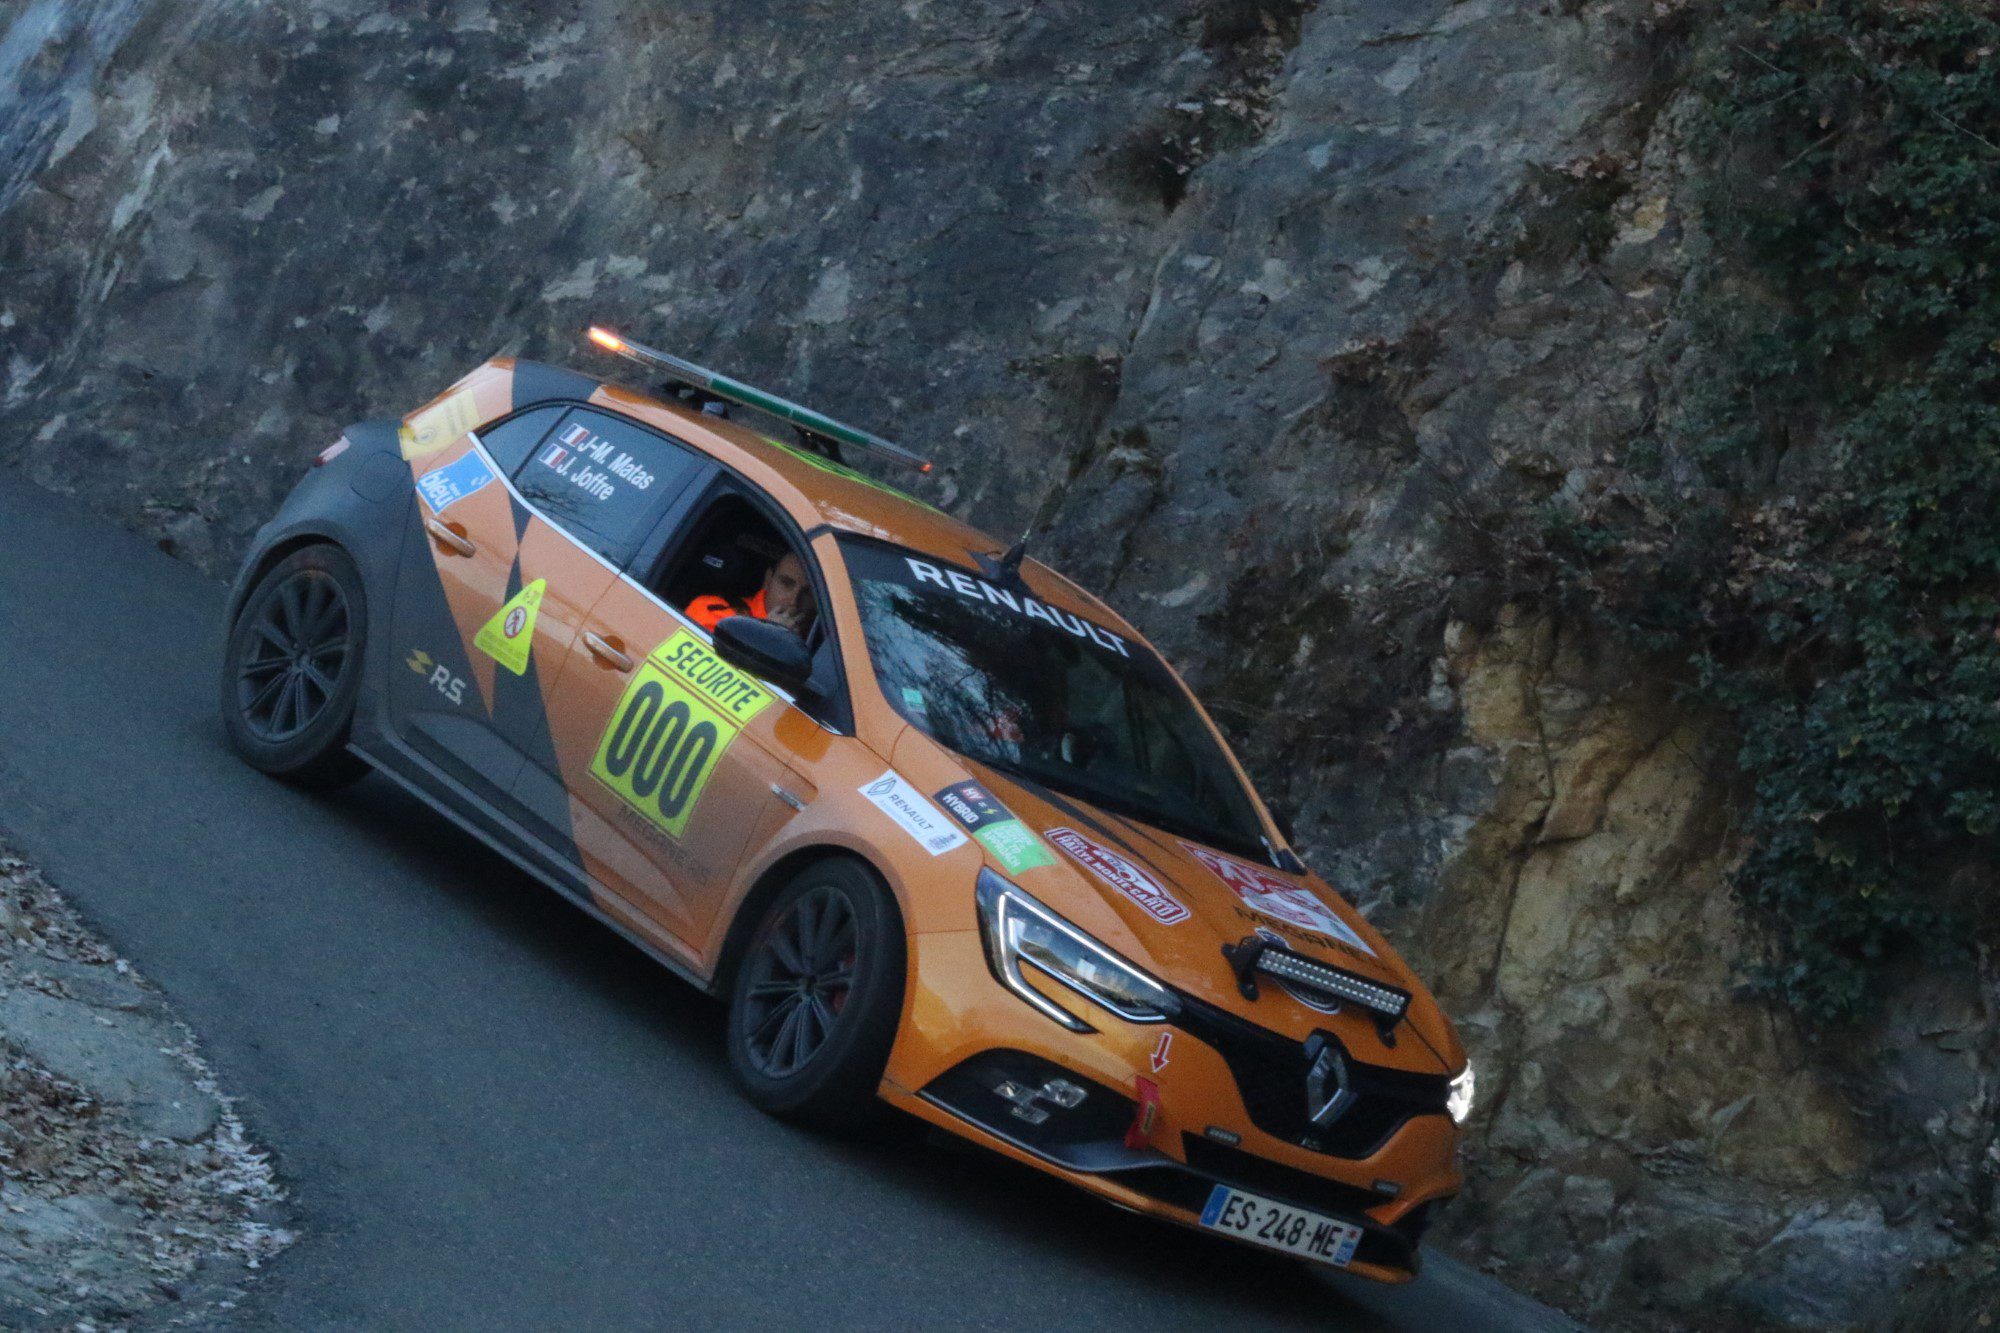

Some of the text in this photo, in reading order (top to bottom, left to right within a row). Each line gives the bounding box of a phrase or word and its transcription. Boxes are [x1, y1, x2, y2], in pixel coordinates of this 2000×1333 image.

[556, 456, 615, 501] J. Joffre
[577, 436, 654, 490] J-M. Matas
[419, 470, 454, 508] bleu
[905, 556, 1130, 659] RENAULT
[666, 640, 762, 713] SECURITE
[605, 680, 718, 819] 000
[888, 793, 934, 832] RENAULT
[942, 792, 980, 824] HYBRID
[1056, 835, 1095, 863] RALLYE
